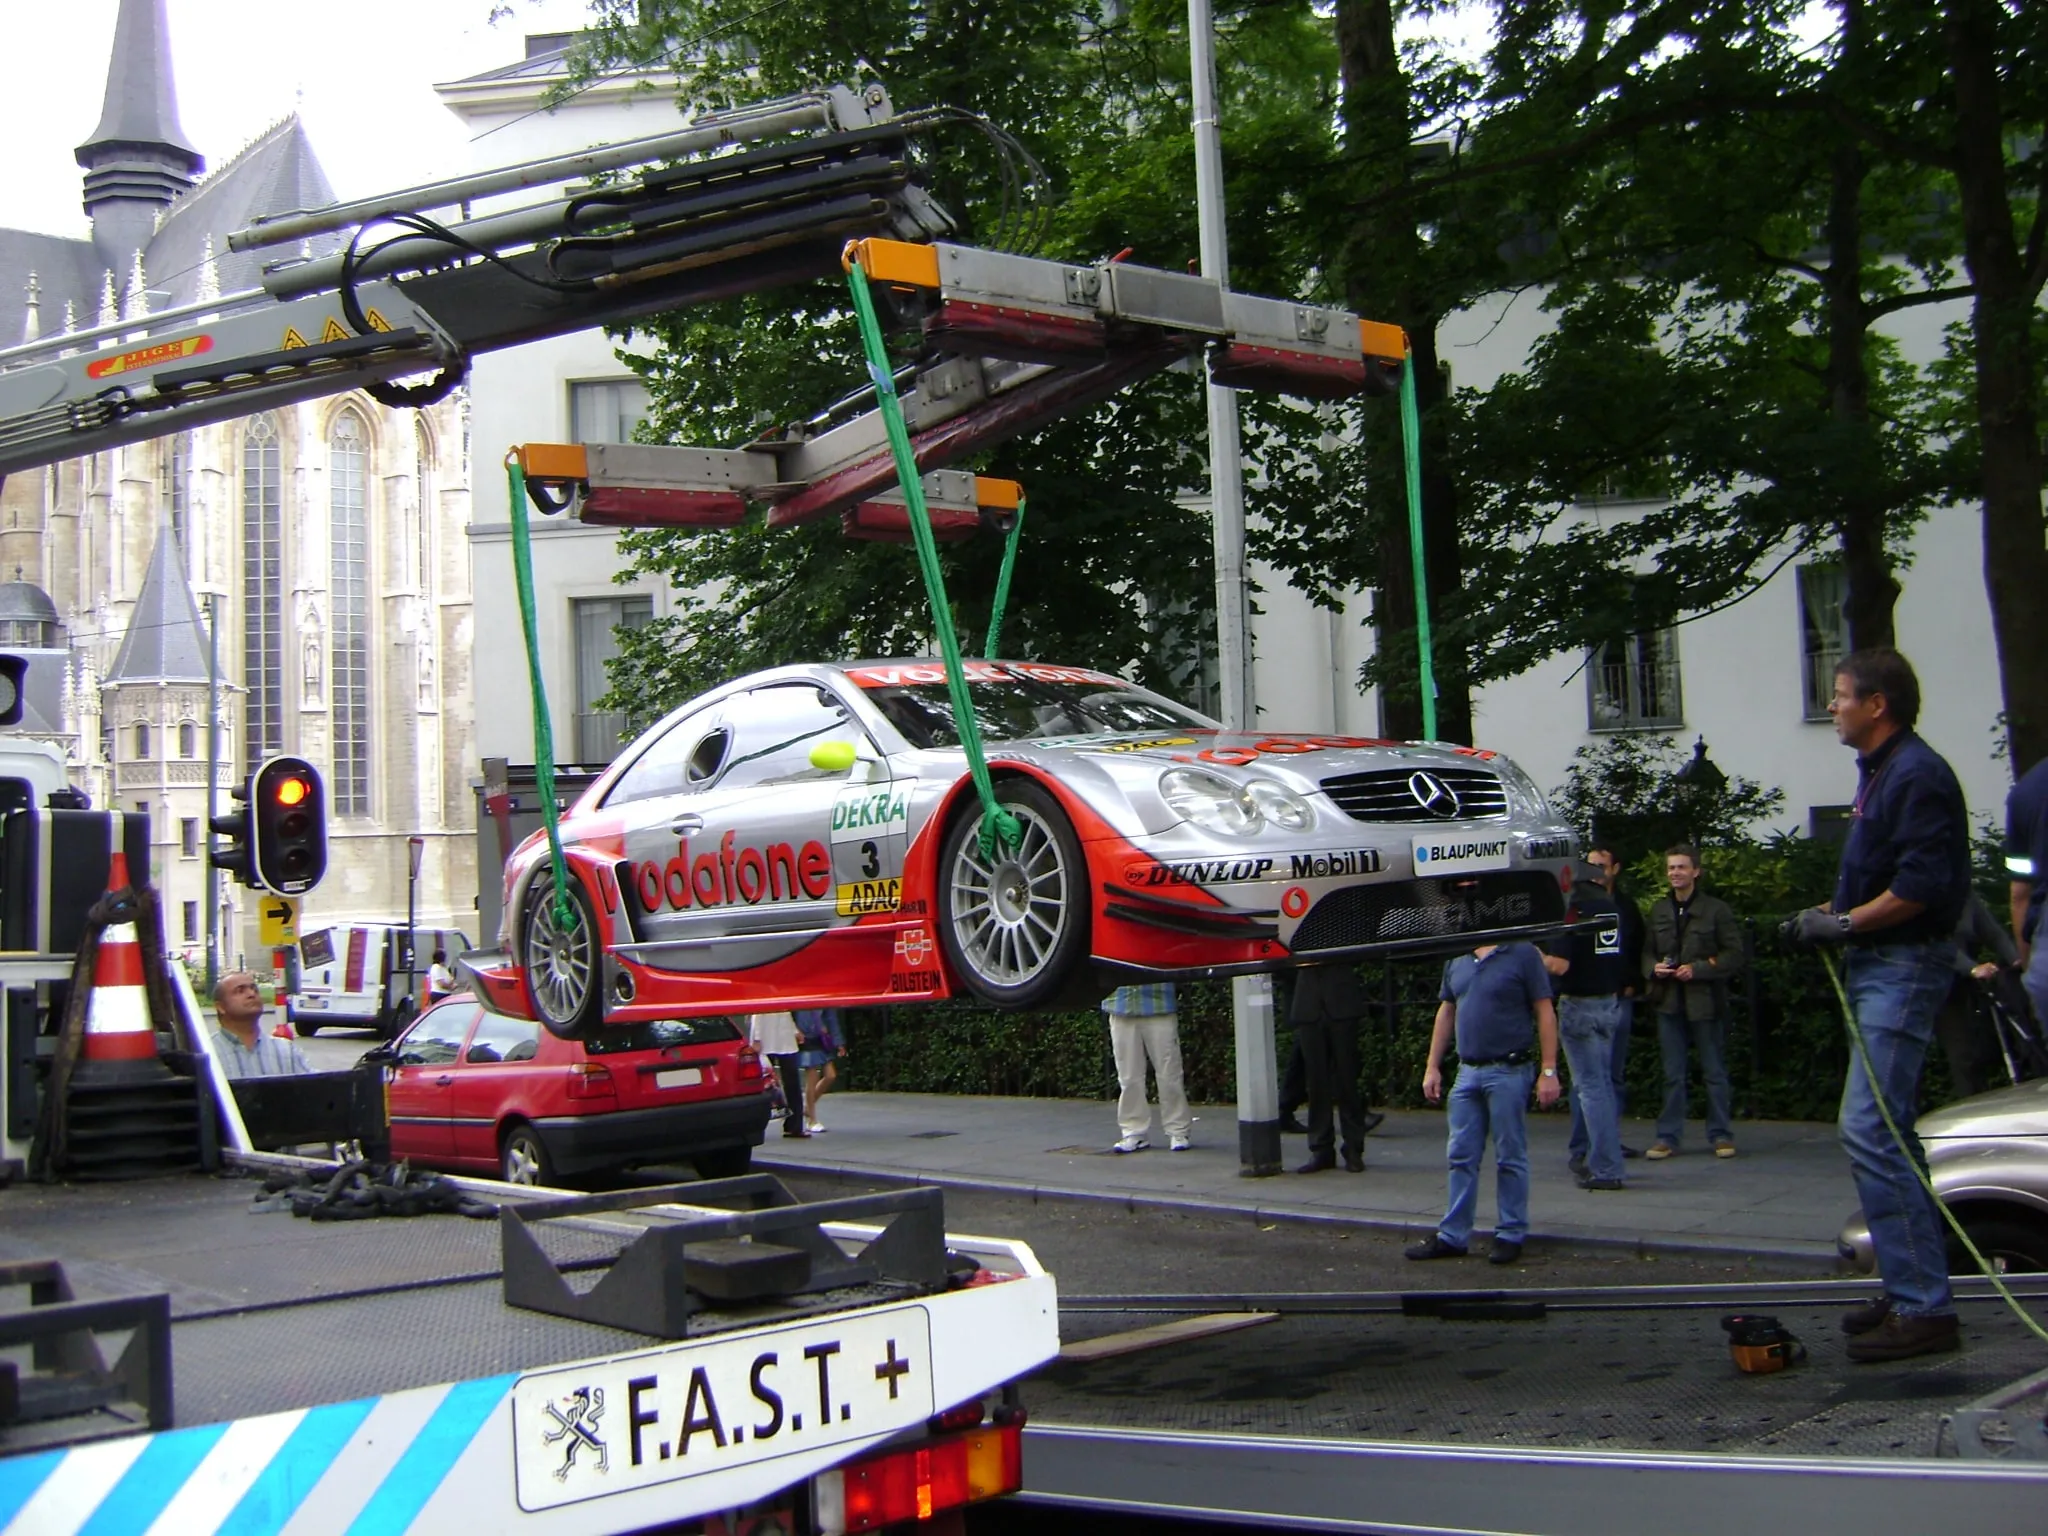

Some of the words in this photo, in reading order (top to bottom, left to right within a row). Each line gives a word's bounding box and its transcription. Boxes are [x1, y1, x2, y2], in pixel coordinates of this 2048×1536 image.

[832, 792, 905, 831] DEKRA
[861, 840, 880, 879] 3
[1430, 840, 1507, 861] BLAUPUNKT
[1146, 859, 1273, 886] DUNLOP
[849, 879, 899, 913] ADAC
[891, 969, 941, 993] BILSTEIN
